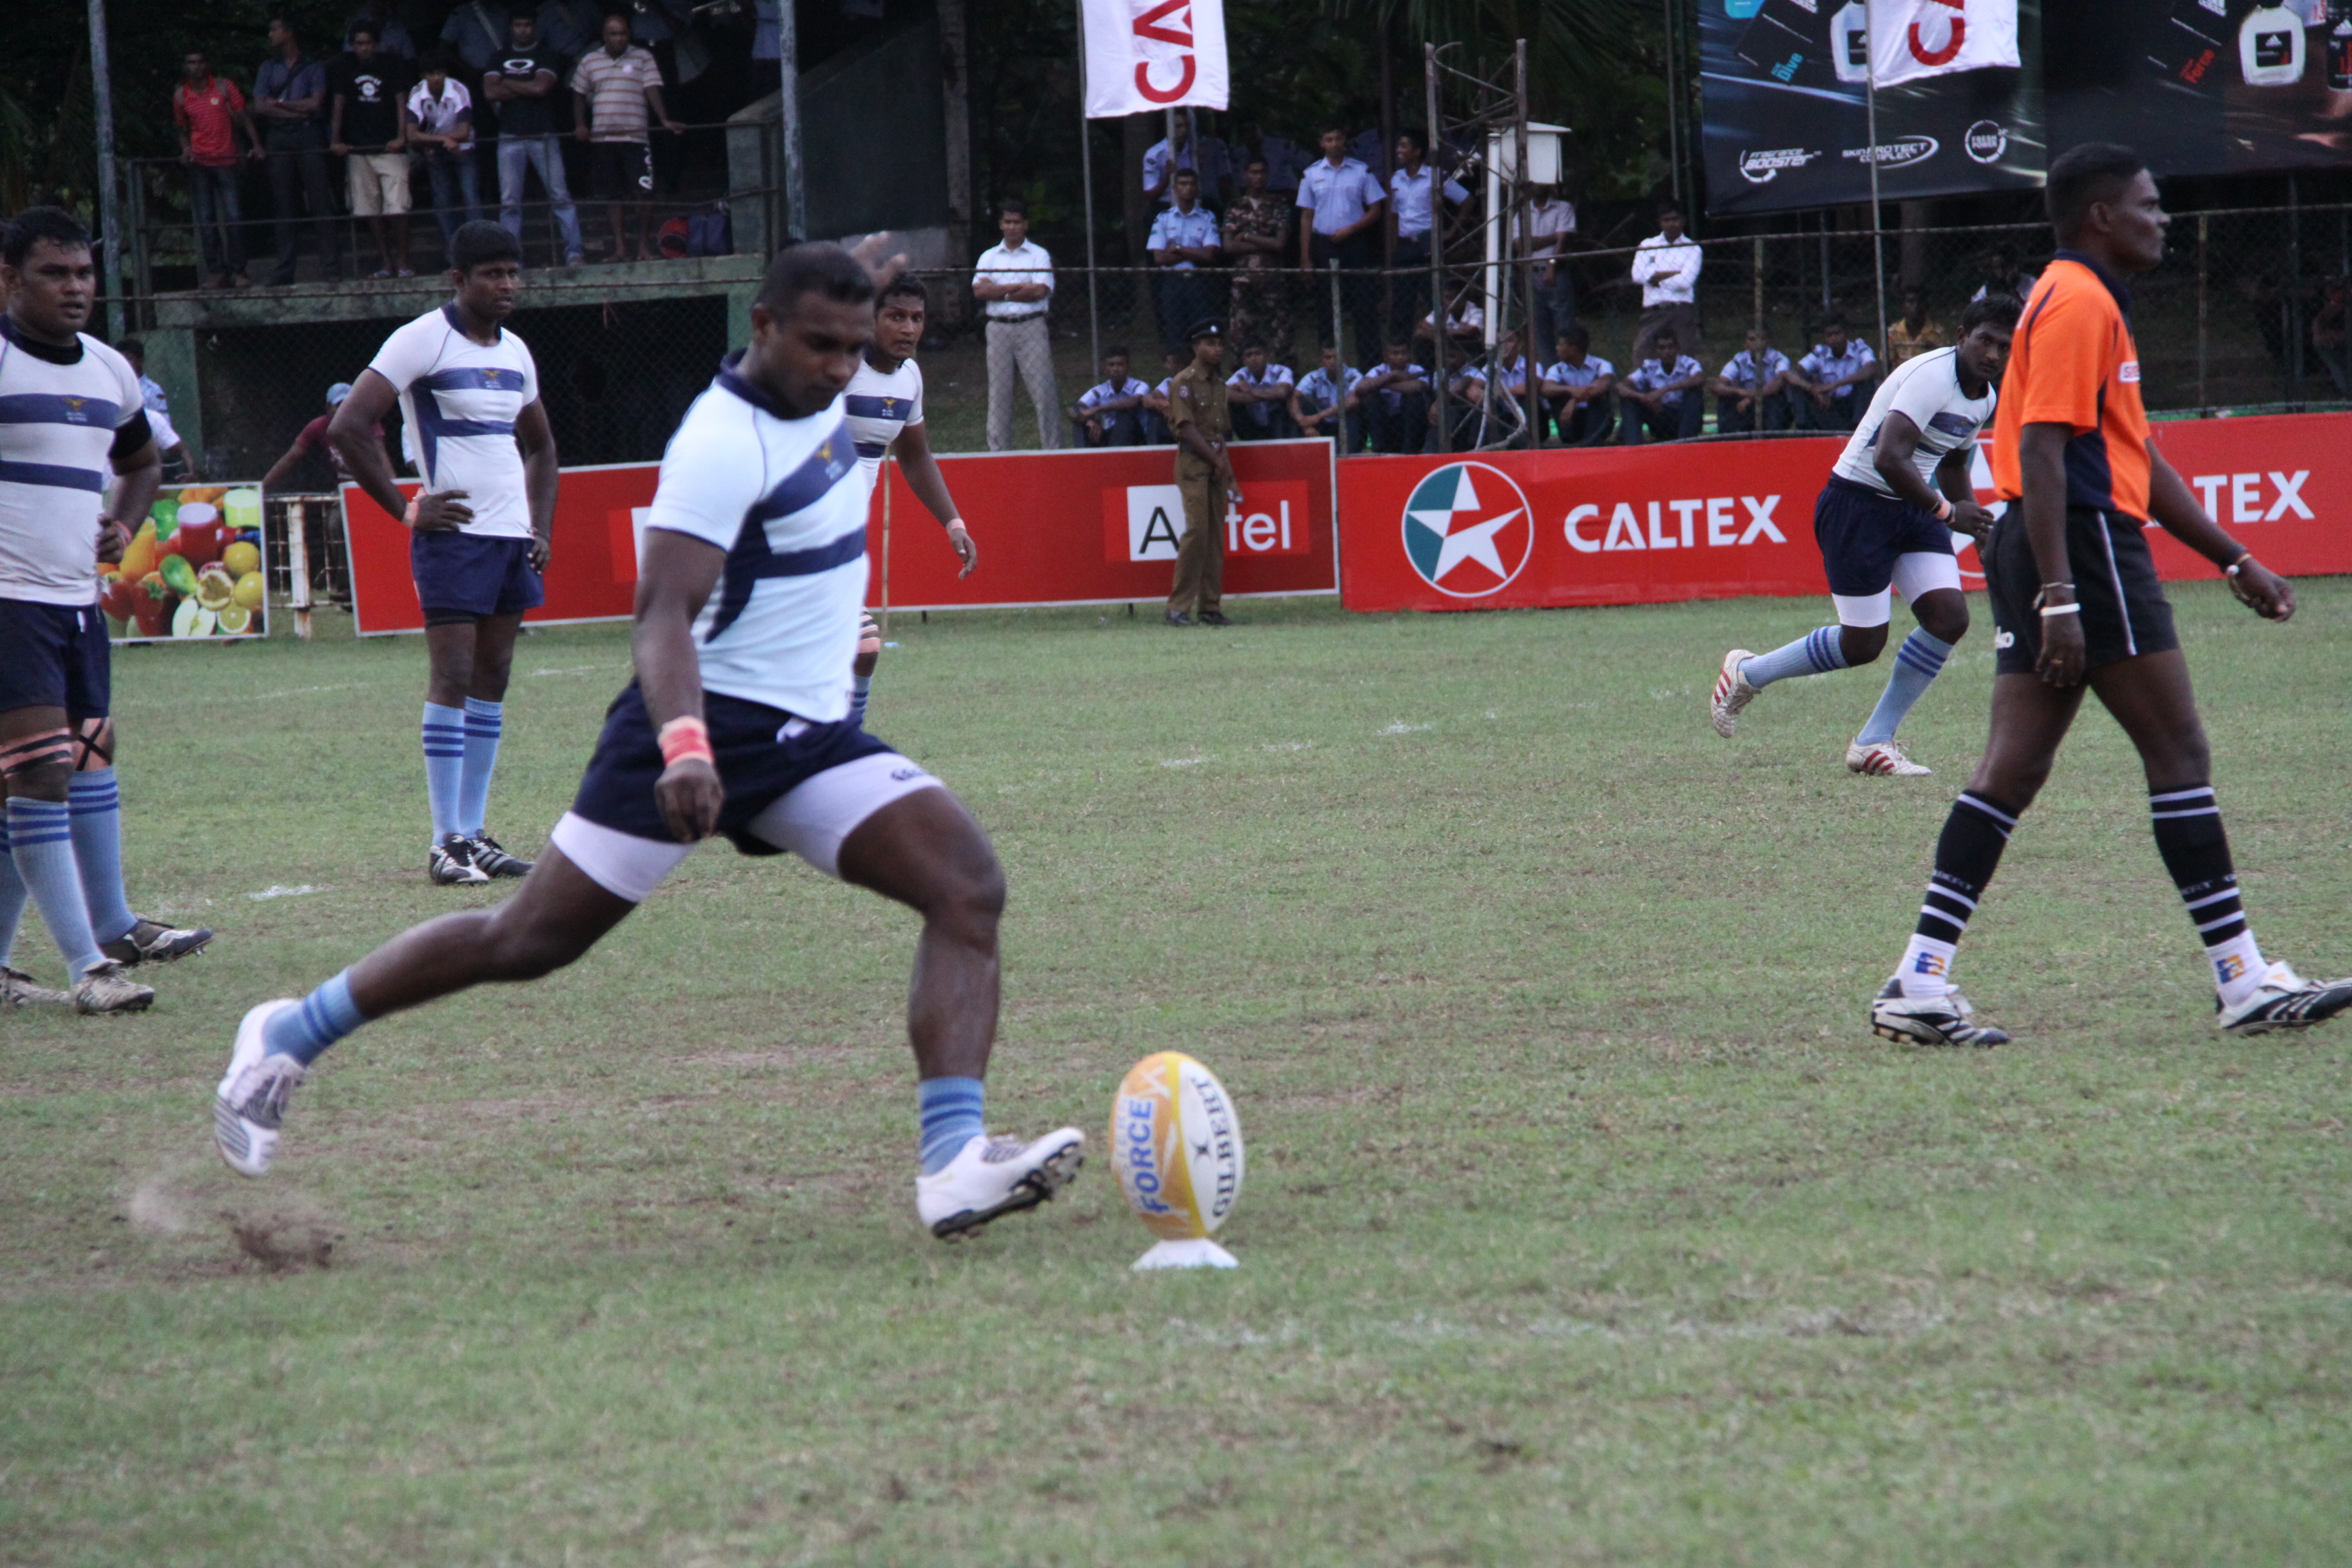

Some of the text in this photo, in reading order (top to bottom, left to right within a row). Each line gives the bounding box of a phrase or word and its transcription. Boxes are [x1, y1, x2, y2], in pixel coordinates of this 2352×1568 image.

[1563, 494, 1788, 553] CALTEX
[2157, 470, 2316, 525] TEX
[1138, 500, 1292, 555] Atel
[1126, 1098, 1170, 1213] FORCE
[1191, 1077, 1235, 1218] GILBERT
